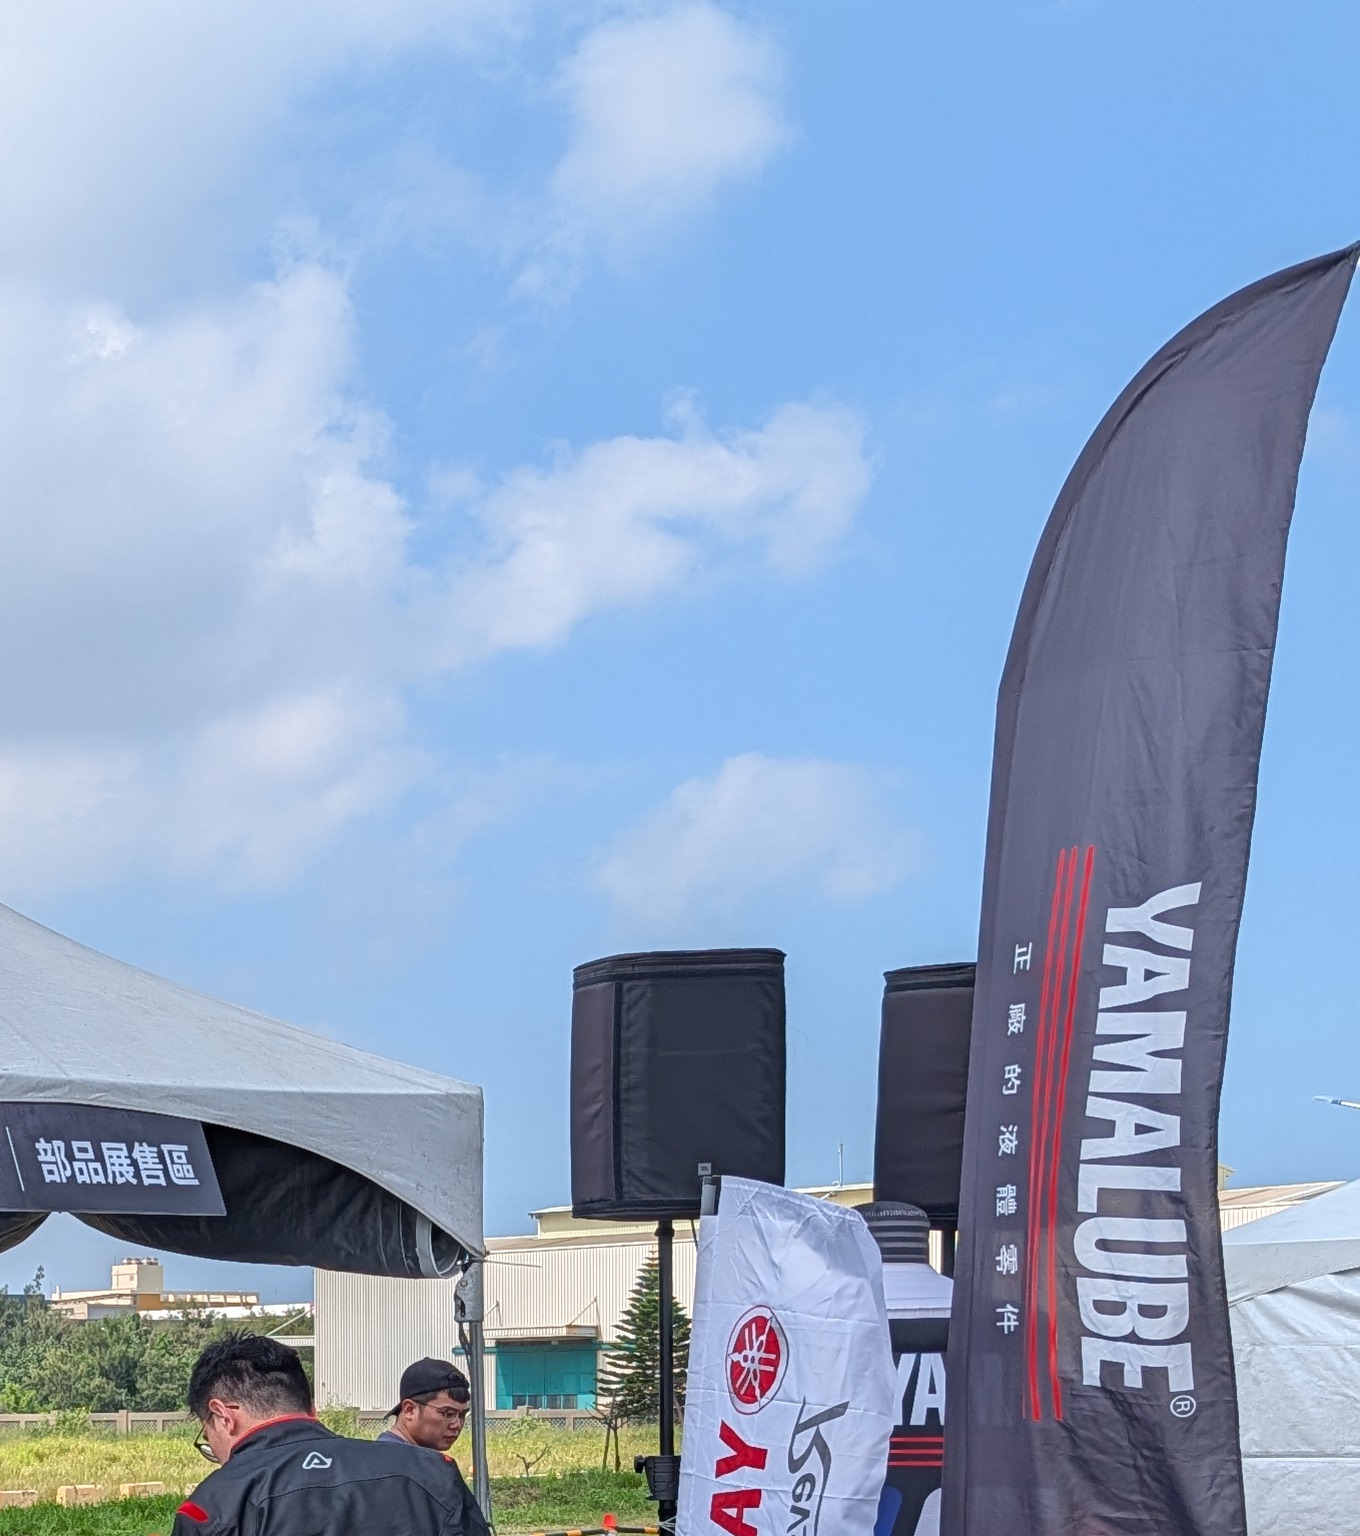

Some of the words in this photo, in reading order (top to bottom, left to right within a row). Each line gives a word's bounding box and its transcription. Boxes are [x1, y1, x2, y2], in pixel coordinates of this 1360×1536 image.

[34, 1137, 201, 1187] 部品展售區
[993, 940, 1033, 1336] 正廠的液體零件
